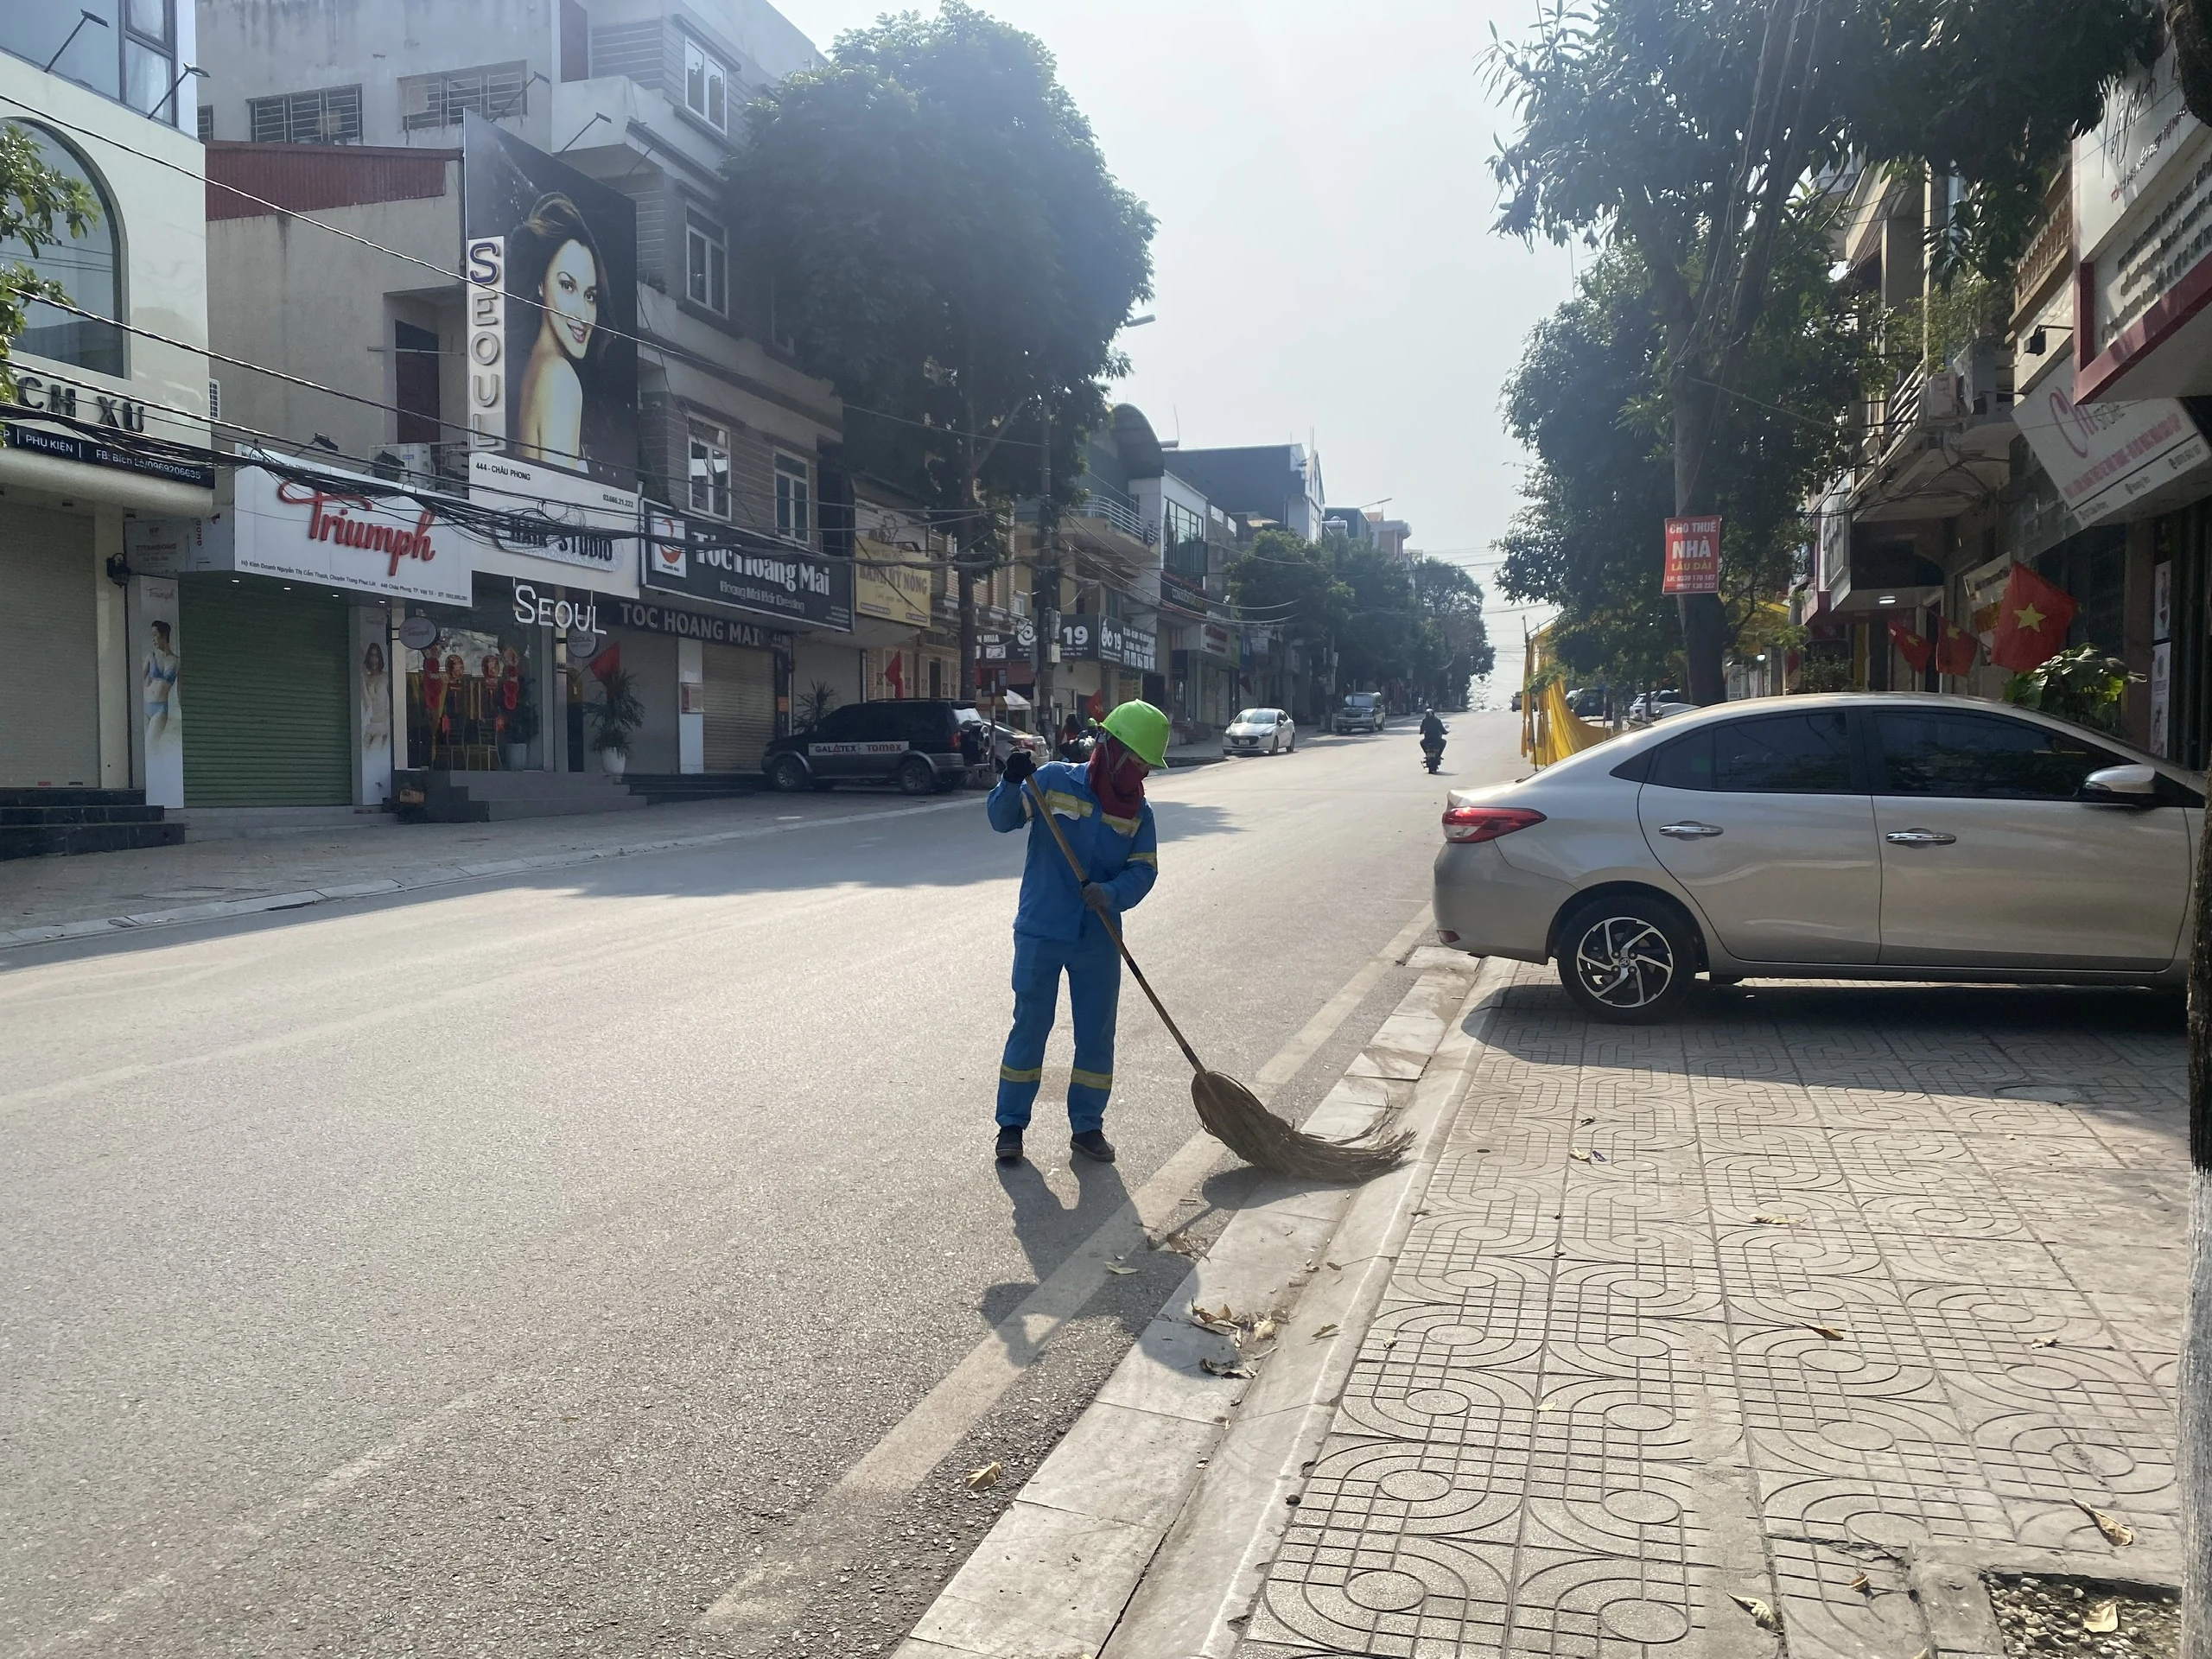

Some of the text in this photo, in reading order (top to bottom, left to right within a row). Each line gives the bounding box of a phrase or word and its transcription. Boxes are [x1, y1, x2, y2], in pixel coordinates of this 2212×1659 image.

[469, 241, 499, 447] SEOUL
[26, 435, 48, 448] PHỤ
[50, 438, 73, 454] KIỆN
[96, 448, 111, 461] FB:
[475, 462, 487, 472] 444
[491, 463, 508, 475] CHÂU
[510, 469, 531, 481] PHONG
[277, 477, 436, 576] Triumph
[1669, 520, 1716, 534] CHO THUÊ
[559, 535, 613, 562] STUDIO
[1672, 536, 1711, 560] NHÀ
[1671, 560, 1712, 571] LÂU DÀI
[798, 563, 830, 596] Mai
[515, 584, 607, 636] SEOUL
[728, 627, 760, 646] MAI
[1063, 626, 1089, 645] 19
[1114, 632, 1122, 651] 19
[816, 743, 857, 753] GALATEX
